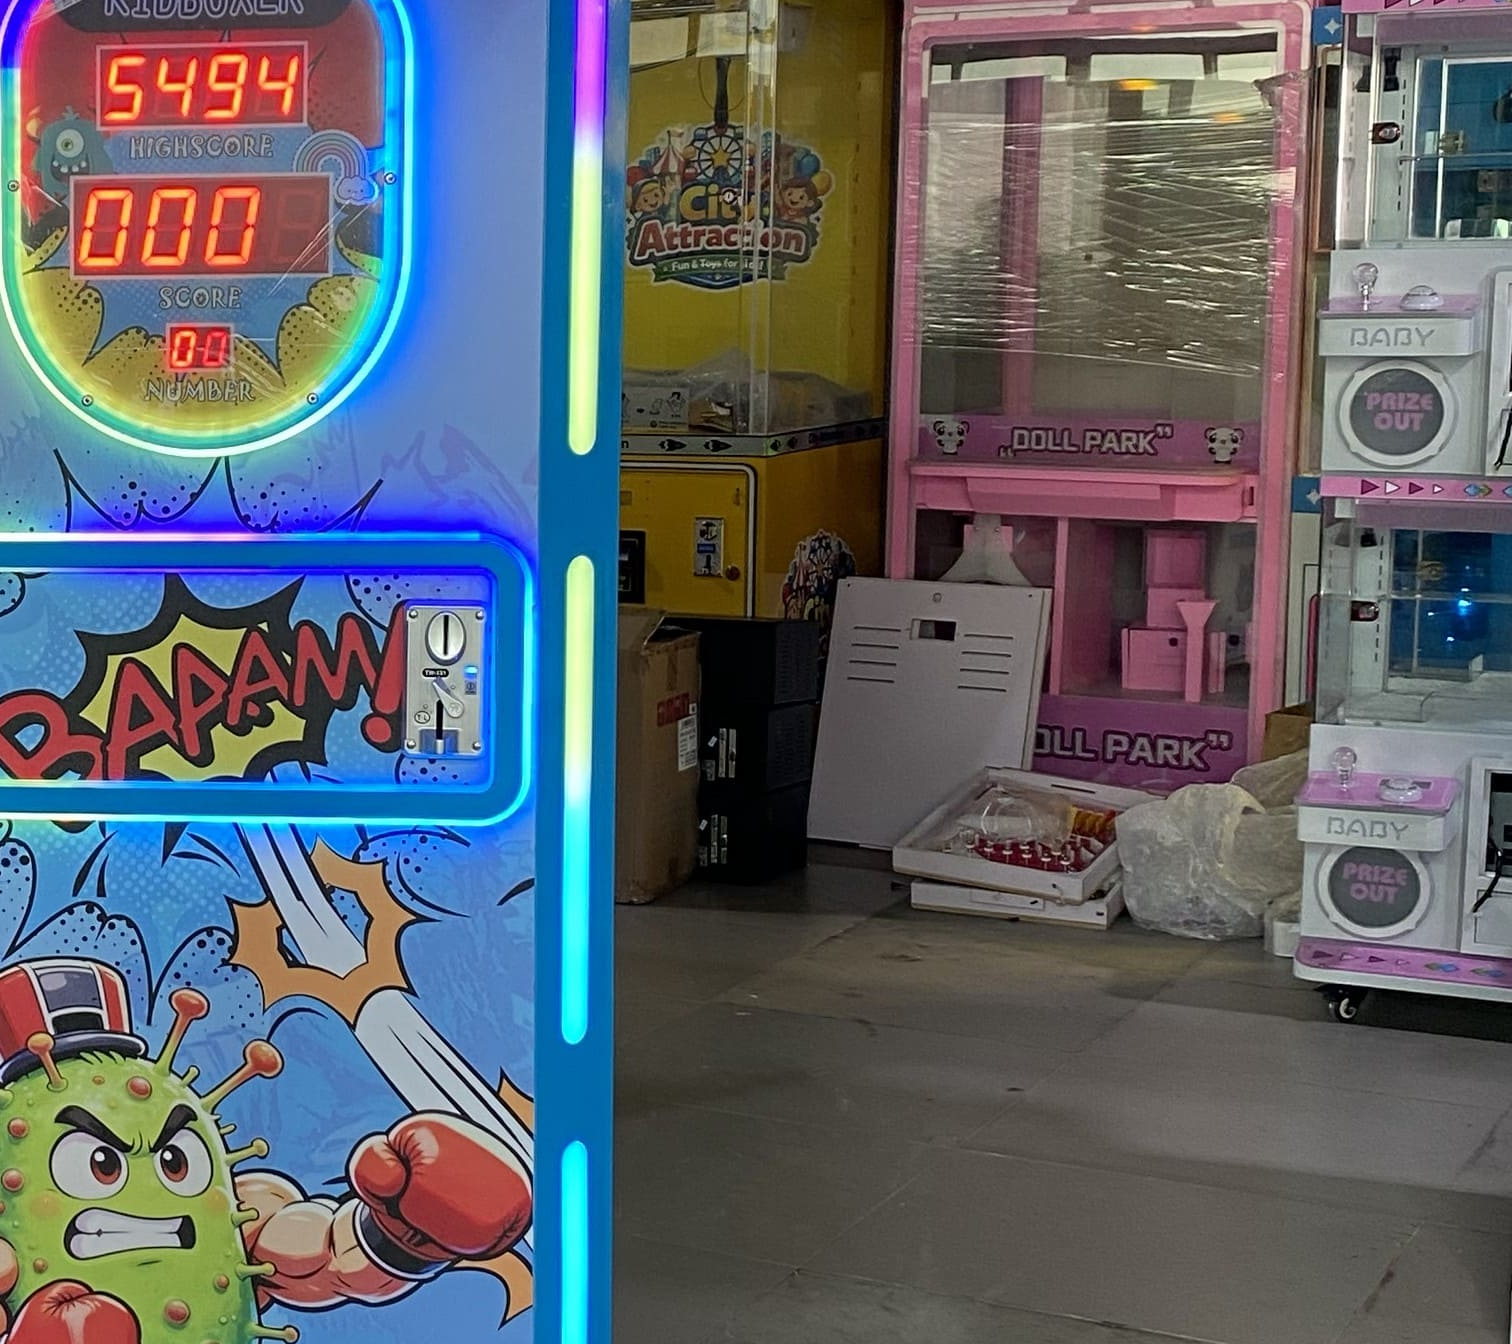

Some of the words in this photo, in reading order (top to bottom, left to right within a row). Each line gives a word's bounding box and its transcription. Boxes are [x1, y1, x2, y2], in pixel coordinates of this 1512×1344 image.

[104, 54, 299, 121] 5494
[129, 134, 274, 159] HIGHSCORE
[78, 188, 261, 268] 000
[159, 286, 243, 310] SCORE
[1350, 327, 1435, 347] BABY
[143, 377, 255, 403] NUMBER
[1366, 392, 1433, 410] PRIZE
[1373, 412, 1425, 432] OUT
[1327, 816, 1408, 841] BABY
[1342, 862, 1408, 887] PRIZE
[1351, 883, 1399, 904] OUT
